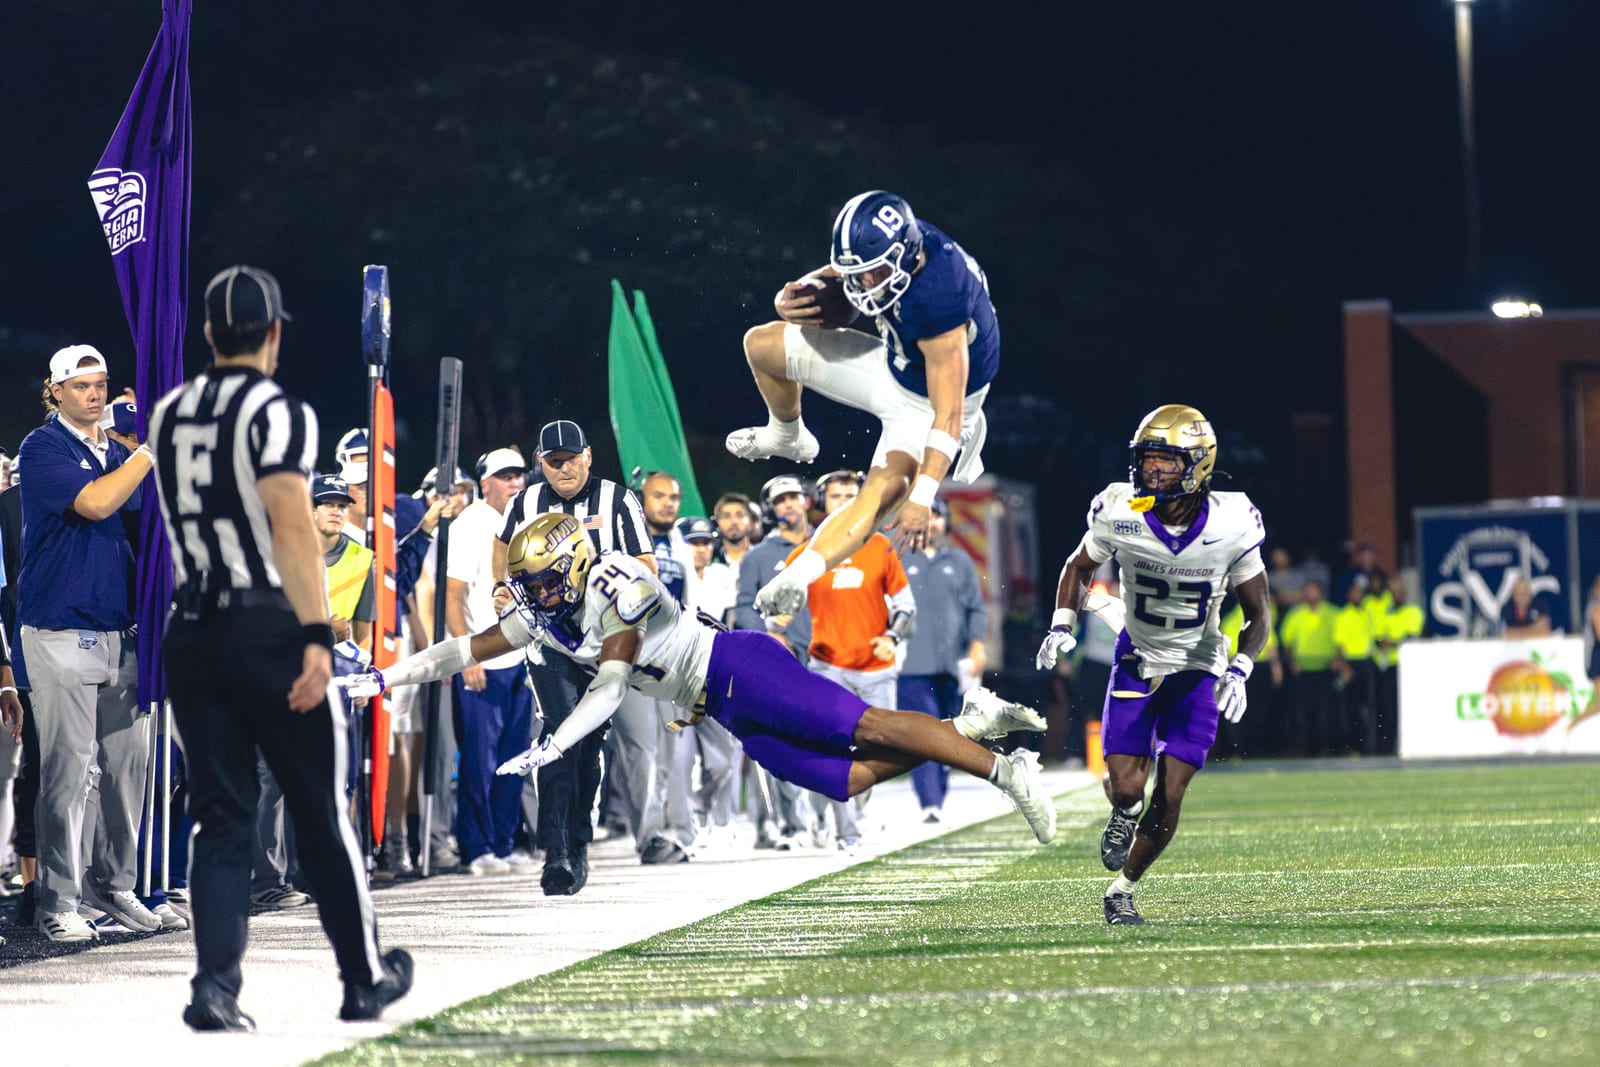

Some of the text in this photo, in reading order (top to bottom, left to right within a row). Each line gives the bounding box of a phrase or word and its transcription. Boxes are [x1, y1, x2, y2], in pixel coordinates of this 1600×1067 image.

[872, 205, 904, 240] 19
[172, 421, 219, 516] F
[544, 517, 579, 554] JMU
[1113, 520, 1142, 536] SBC
[592, 563, 632, 601] 24
[1133, 561, 1216, 577] JAMES MADISON
[1134, 573, 1213, 630] 23
